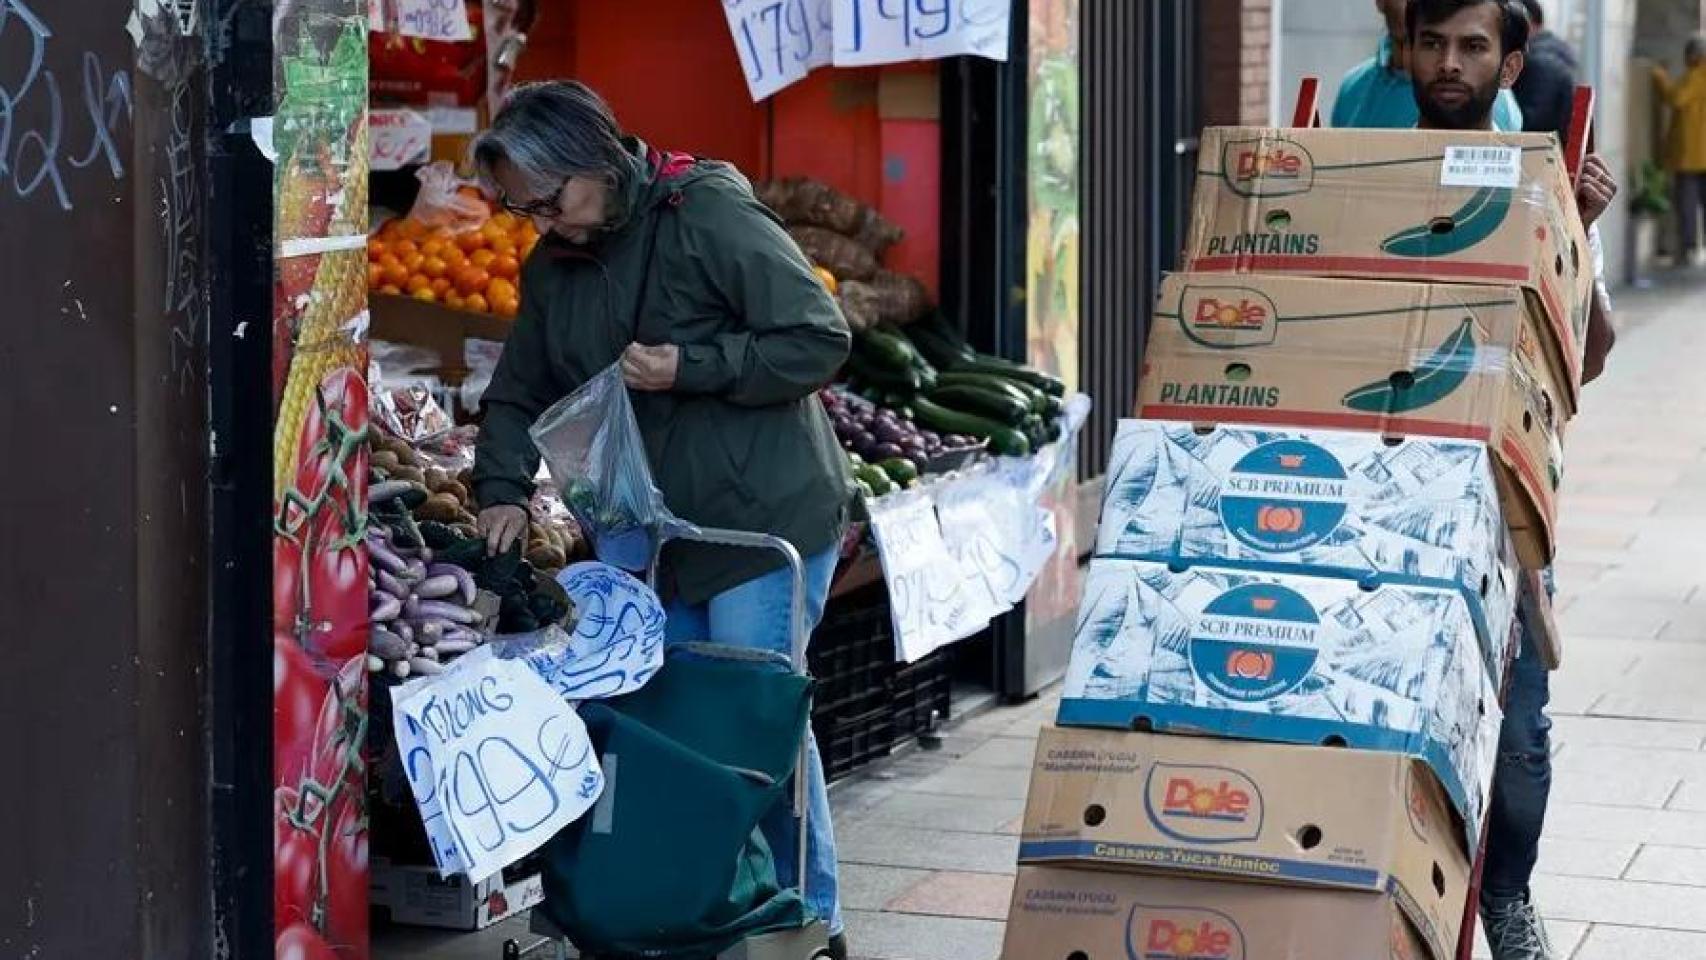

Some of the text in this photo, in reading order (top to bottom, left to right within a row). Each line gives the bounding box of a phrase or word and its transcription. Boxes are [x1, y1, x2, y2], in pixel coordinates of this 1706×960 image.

[1236, 149, 1303, 178] Dole
[1207, 232, 1319, 256] PLANTAINS
[1195, 298, 1267, 328] Dole
[1160, 383, 1280, 407] PLANTAINS
[1229, 478, 1344, 497] SCB PREMIUM
[1200, 620, 1316, 643] SCB PREMIUM
[1162, 777, 1251, 817] Dole
[1094, 843, 1281, 874] Cassava-Yuca-Manioc
[1147, 918, 1232, 956] Dole
